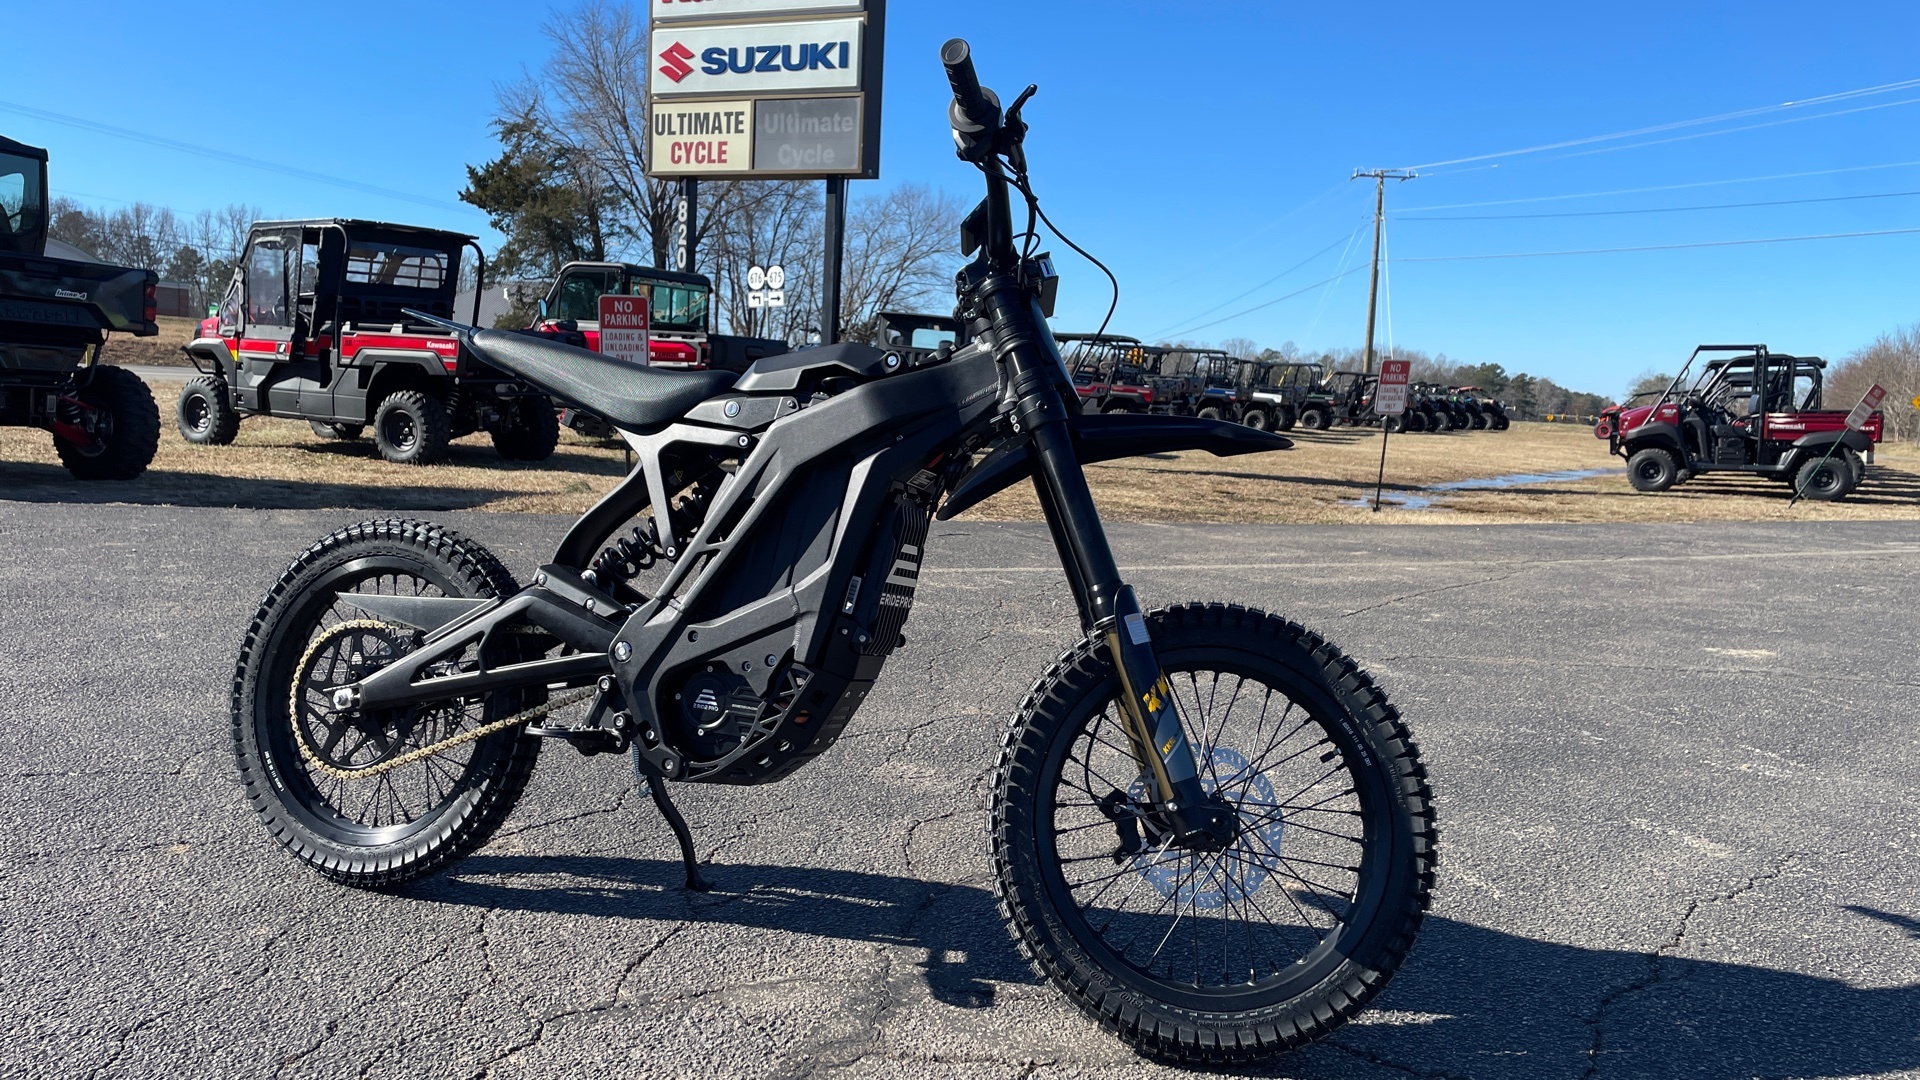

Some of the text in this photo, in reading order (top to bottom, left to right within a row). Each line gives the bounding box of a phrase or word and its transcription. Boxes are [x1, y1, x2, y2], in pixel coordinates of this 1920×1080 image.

[701, 41, 849, 75] SUZUKI
[655, 111, 745, 136] ULTIMATE
[764, 111, 854, 134] Ultimate
[670, 141, 728, 164] CYCLE
[777, 143, 835, 166] Cycle
[750, 272, 762, 284] 676
[769, 271, 782, 284] 675
[614, 301, 633, 313] NO
[604, 313, 644, 326] PARKING
[605, 332, 635, 341] LOADING
[426, 340, 455, 350] Kawasaki
[605, 343, 645, 352] UNLOADING
[1390, 363, 1402, 372] NO
[1382, 373, 1407, 383] PARKING
[1769, 422, 1805, 430] Kawasaki
